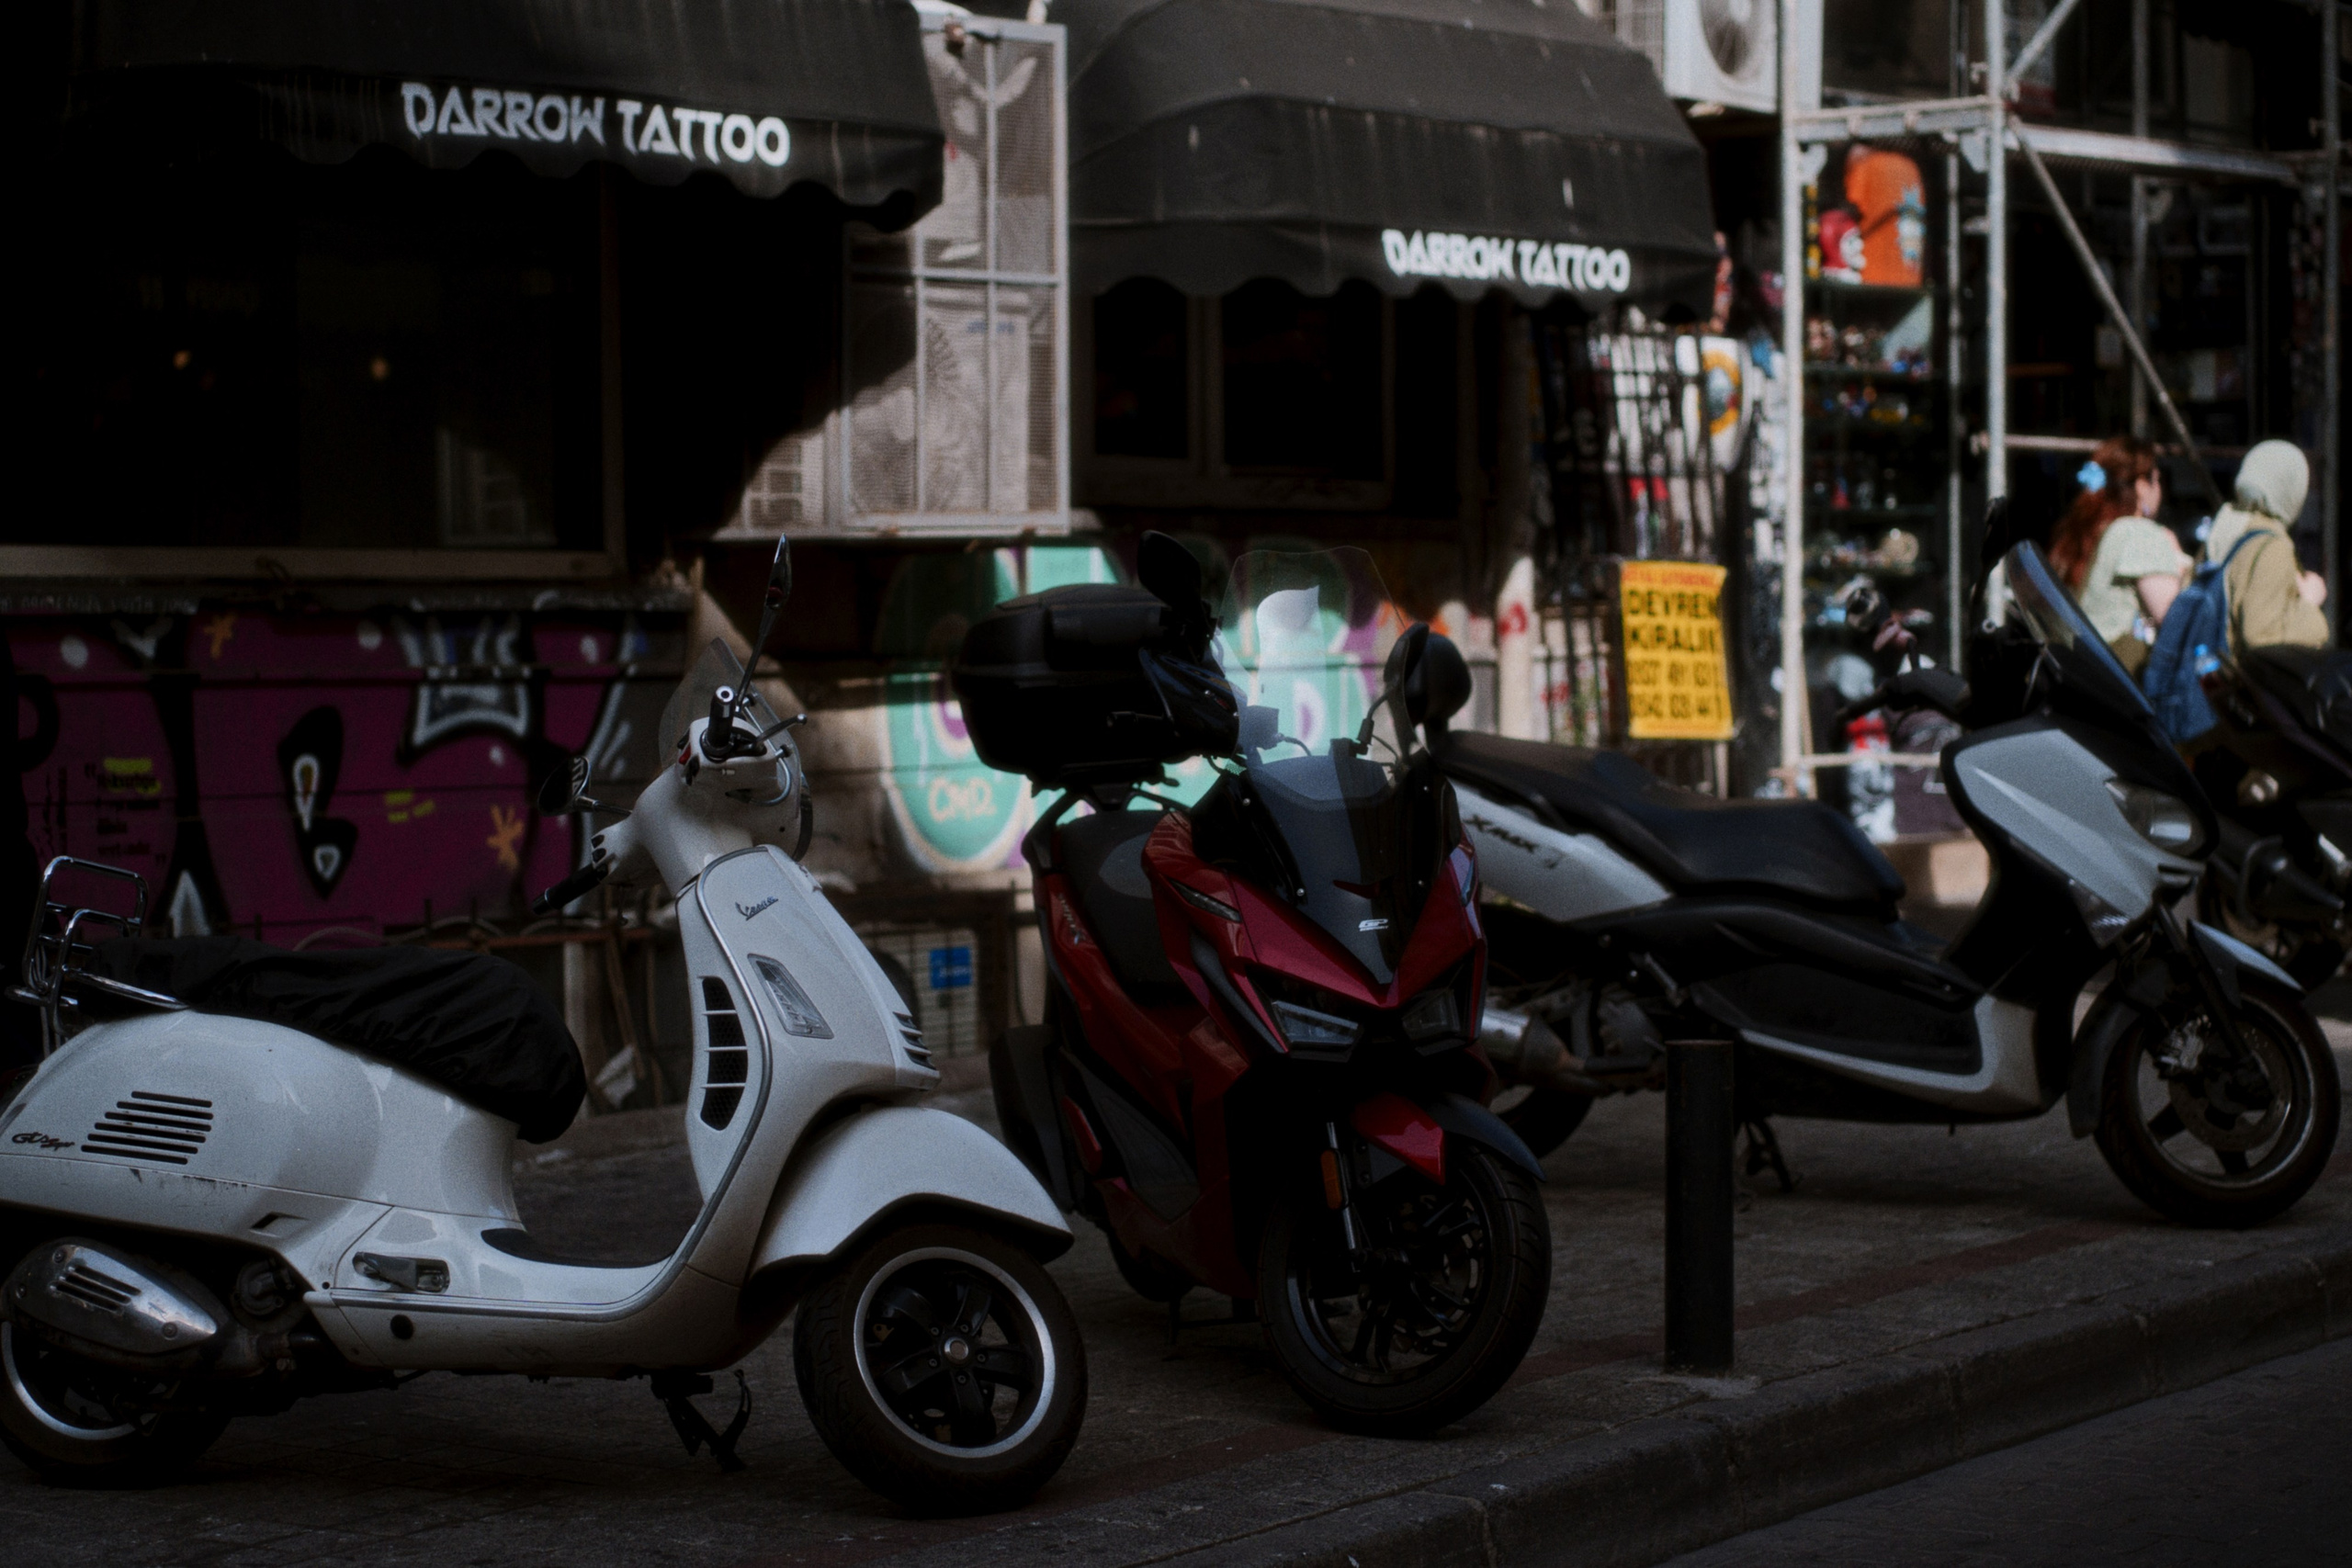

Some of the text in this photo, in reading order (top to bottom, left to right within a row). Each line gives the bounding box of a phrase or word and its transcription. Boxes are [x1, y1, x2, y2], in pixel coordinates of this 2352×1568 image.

[401, 82, 791, 167] DARROW TATTOO
[1381, 228, 1632, 293] DARROW TATTOO
[735, 897, 779, 921] Vespa
